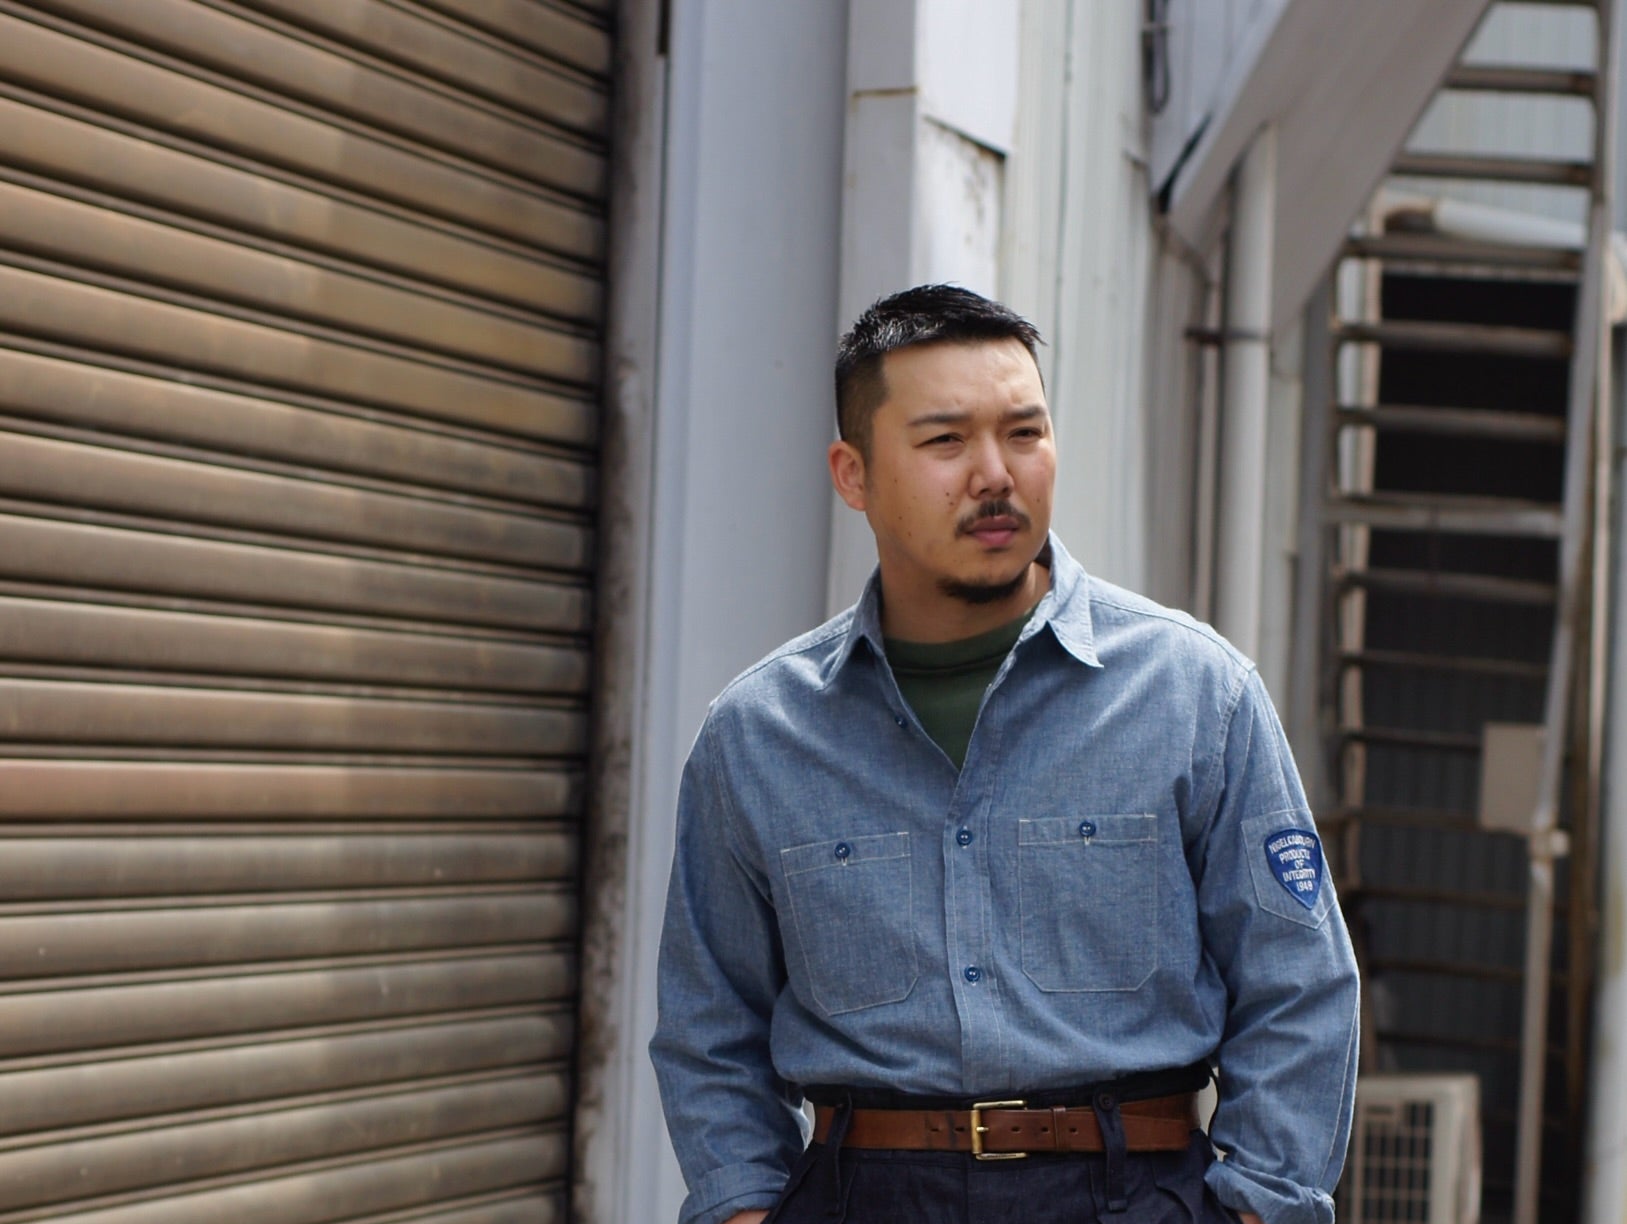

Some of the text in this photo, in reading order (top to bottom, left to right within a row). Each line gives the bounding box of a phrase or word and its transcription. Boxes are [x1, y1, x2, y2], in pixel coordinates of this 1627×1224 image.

[1294, 859, 1305, 869] OF
[1282, 868, 1315, 882] INTEGRITY
[1296, 880, 1313, 892] 1949
